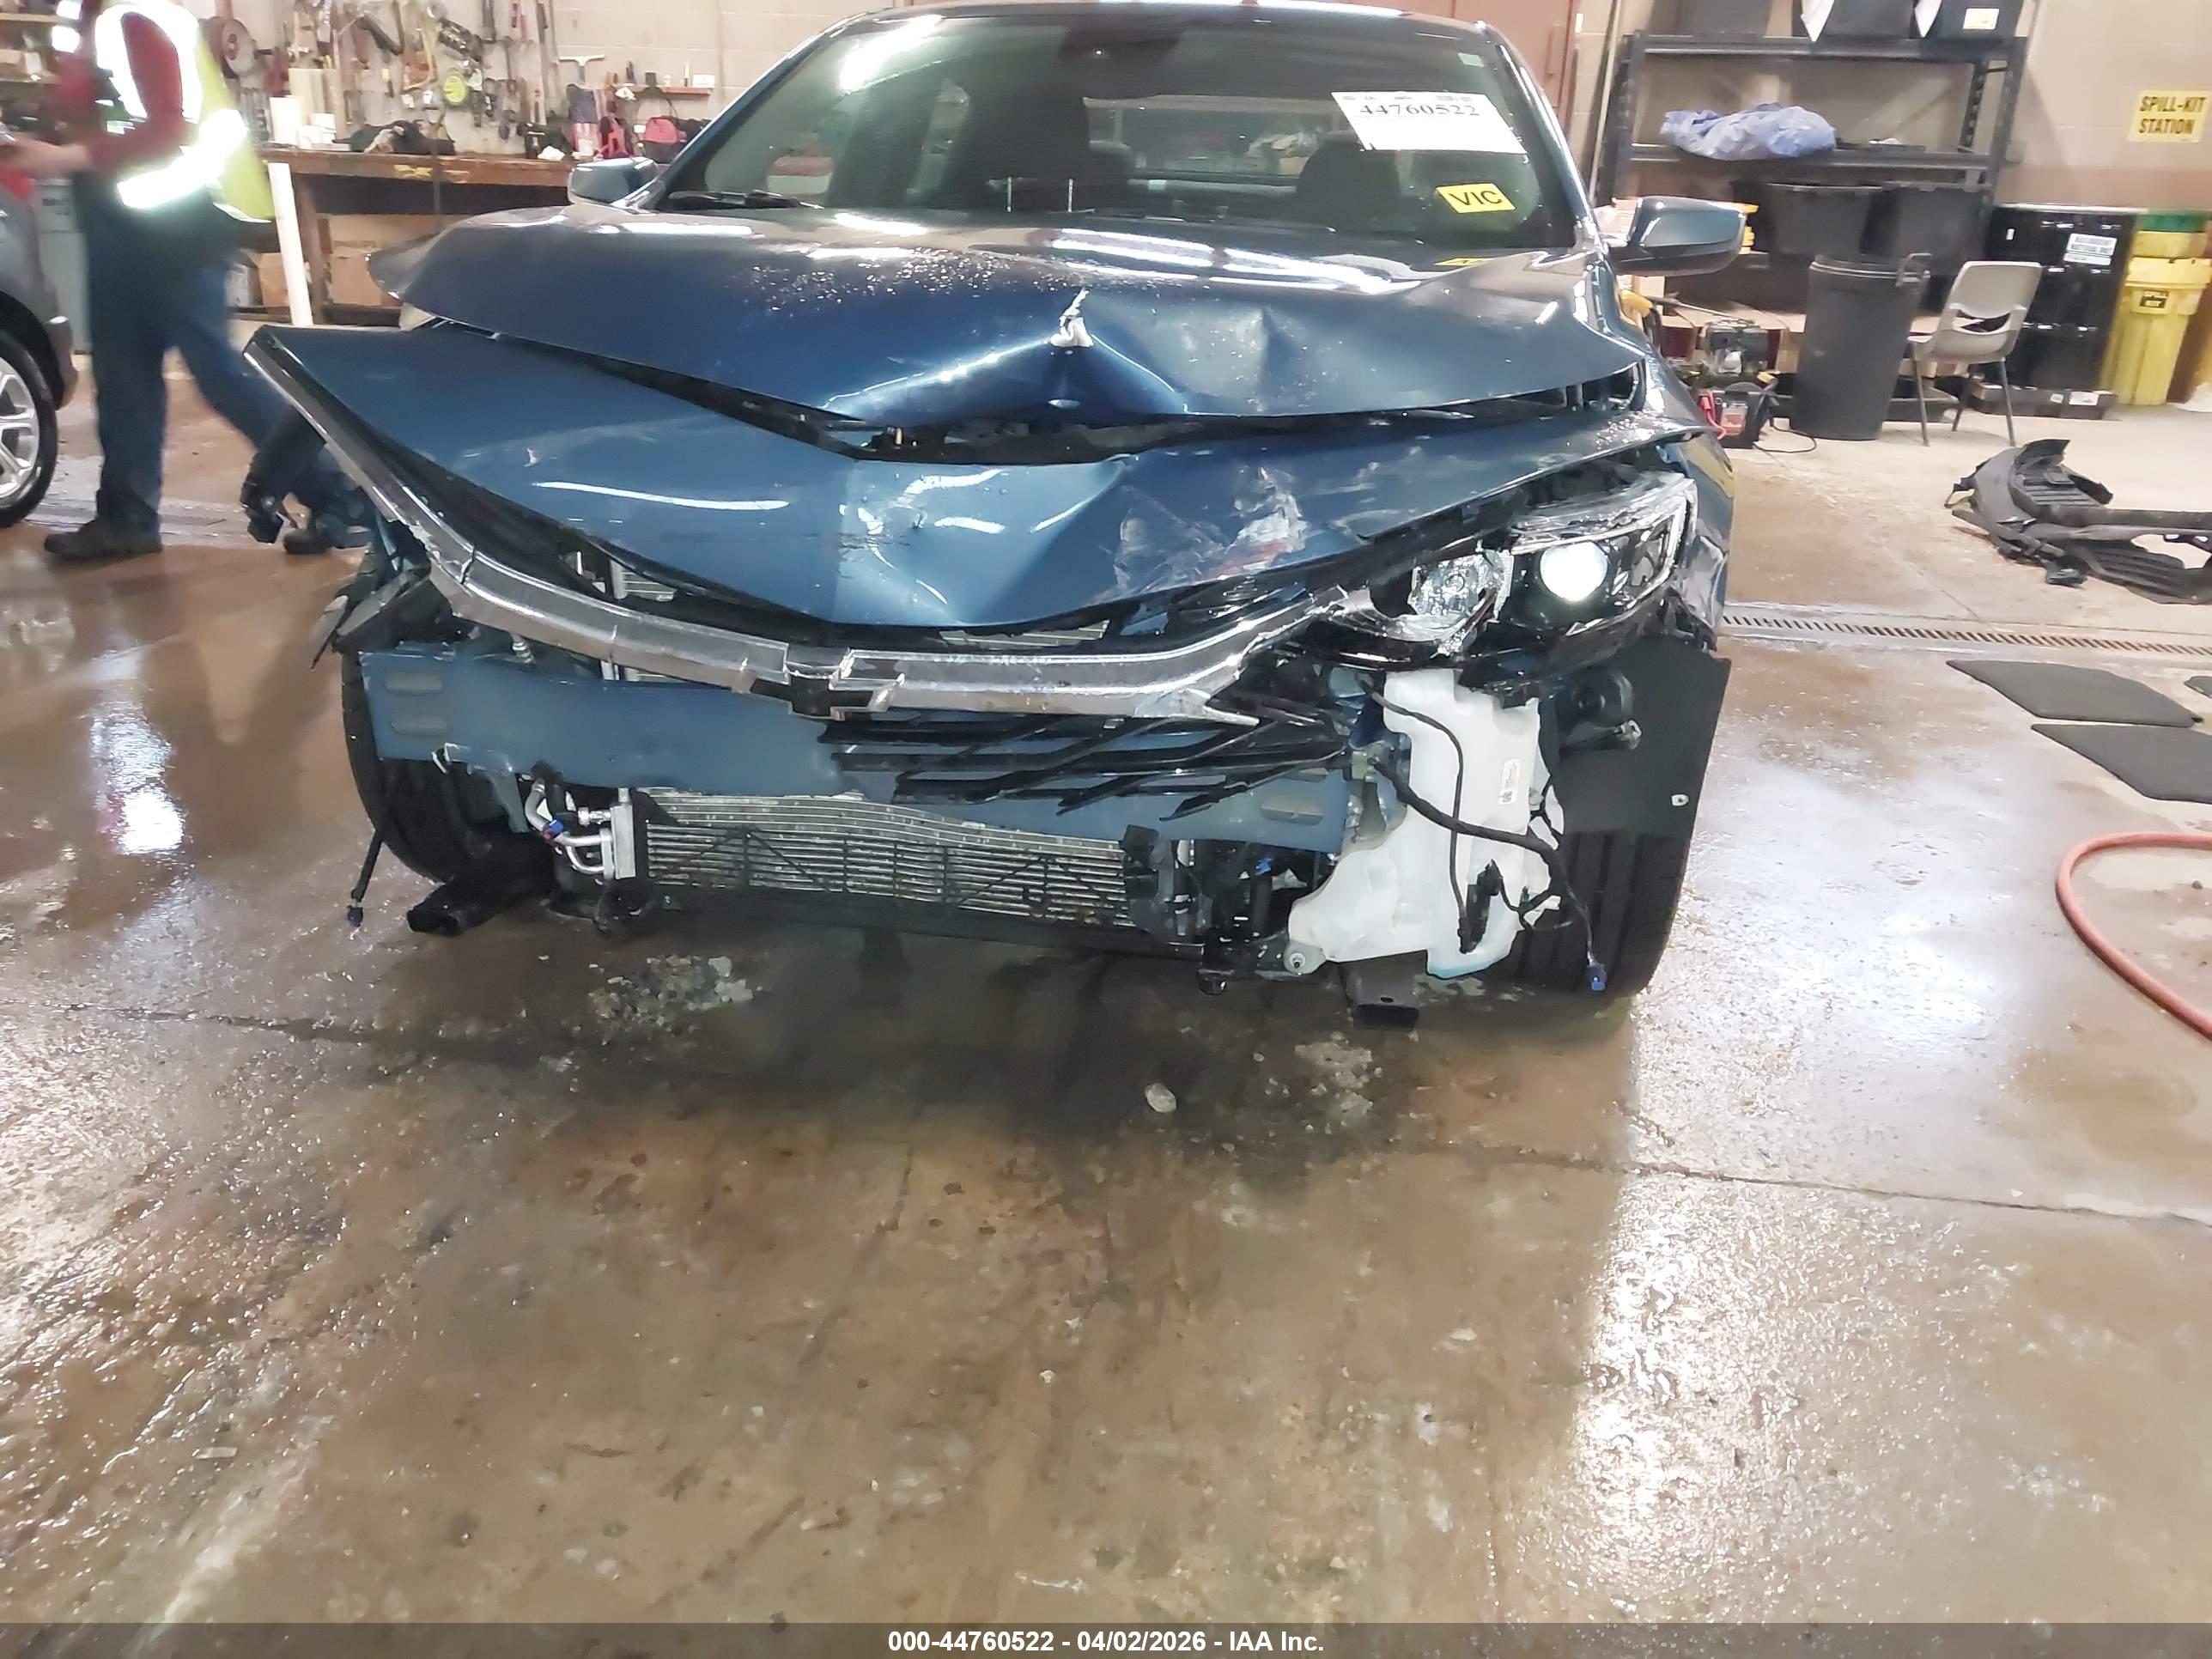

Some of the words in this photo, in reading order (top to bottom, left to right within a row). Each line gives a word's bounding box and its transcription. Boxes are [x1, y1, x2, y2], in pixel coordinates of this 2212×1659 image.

[1360, 105, 1480, 116] 44760522
[2140, 96, 2207, 112] SPILL-KIT
[2139, 118, 2195, 134] STATION
[1449, 191, 1503, 206] VIC
